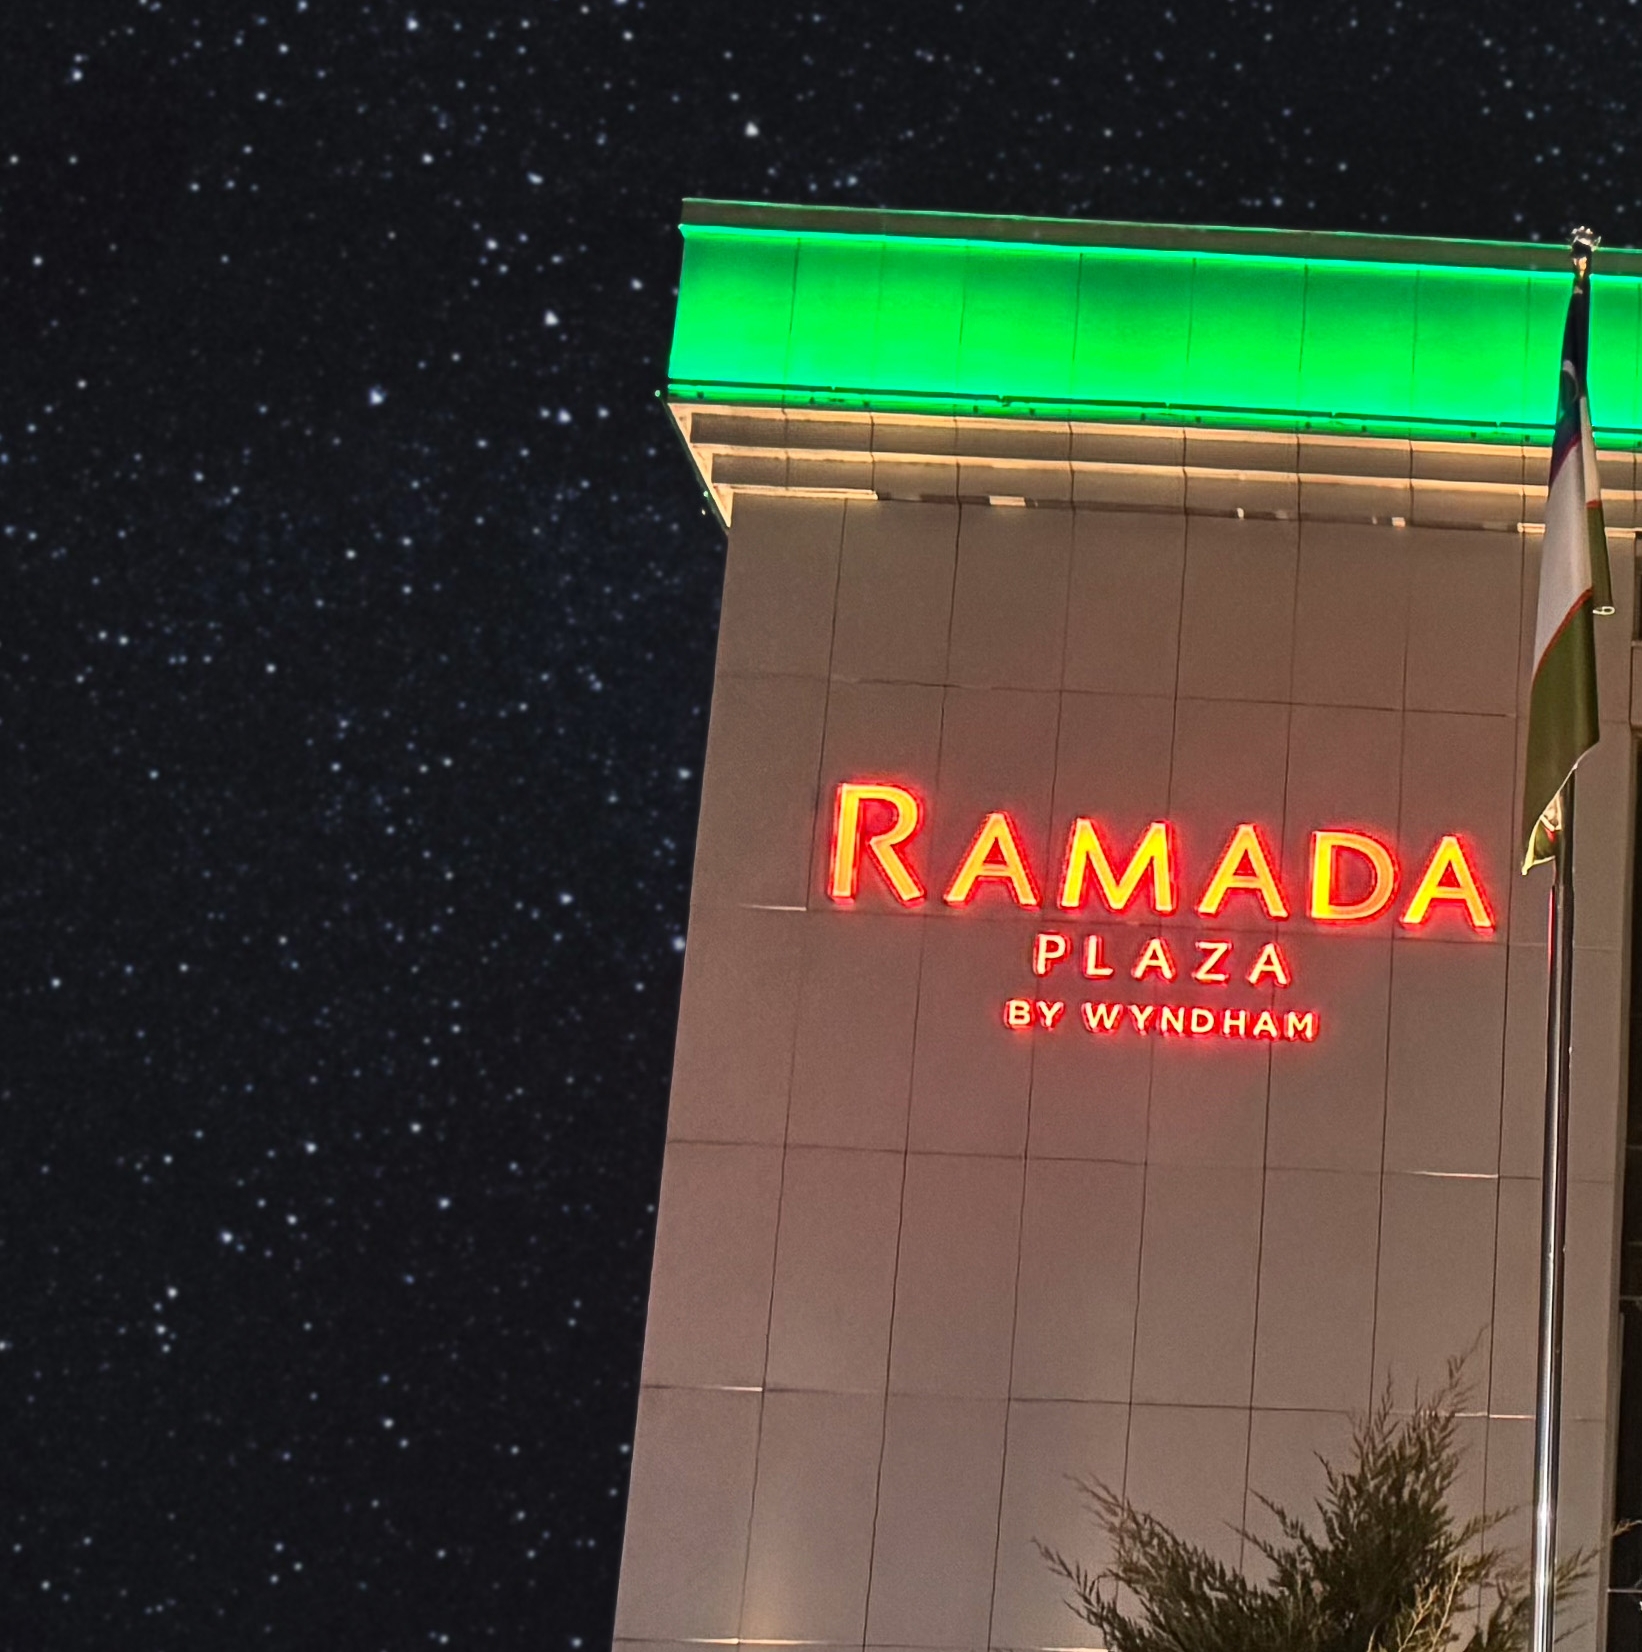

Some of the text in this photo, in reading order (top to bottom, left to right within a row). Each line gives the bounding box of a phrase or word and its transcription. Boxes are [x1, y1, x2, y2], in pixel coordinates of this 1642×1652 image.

[828, 783, 1494, 934] RAMADA
[1033, 933, 1291, 985] PLAZA
[1005, 999, 1320, 1041] BY WYNDHAM
